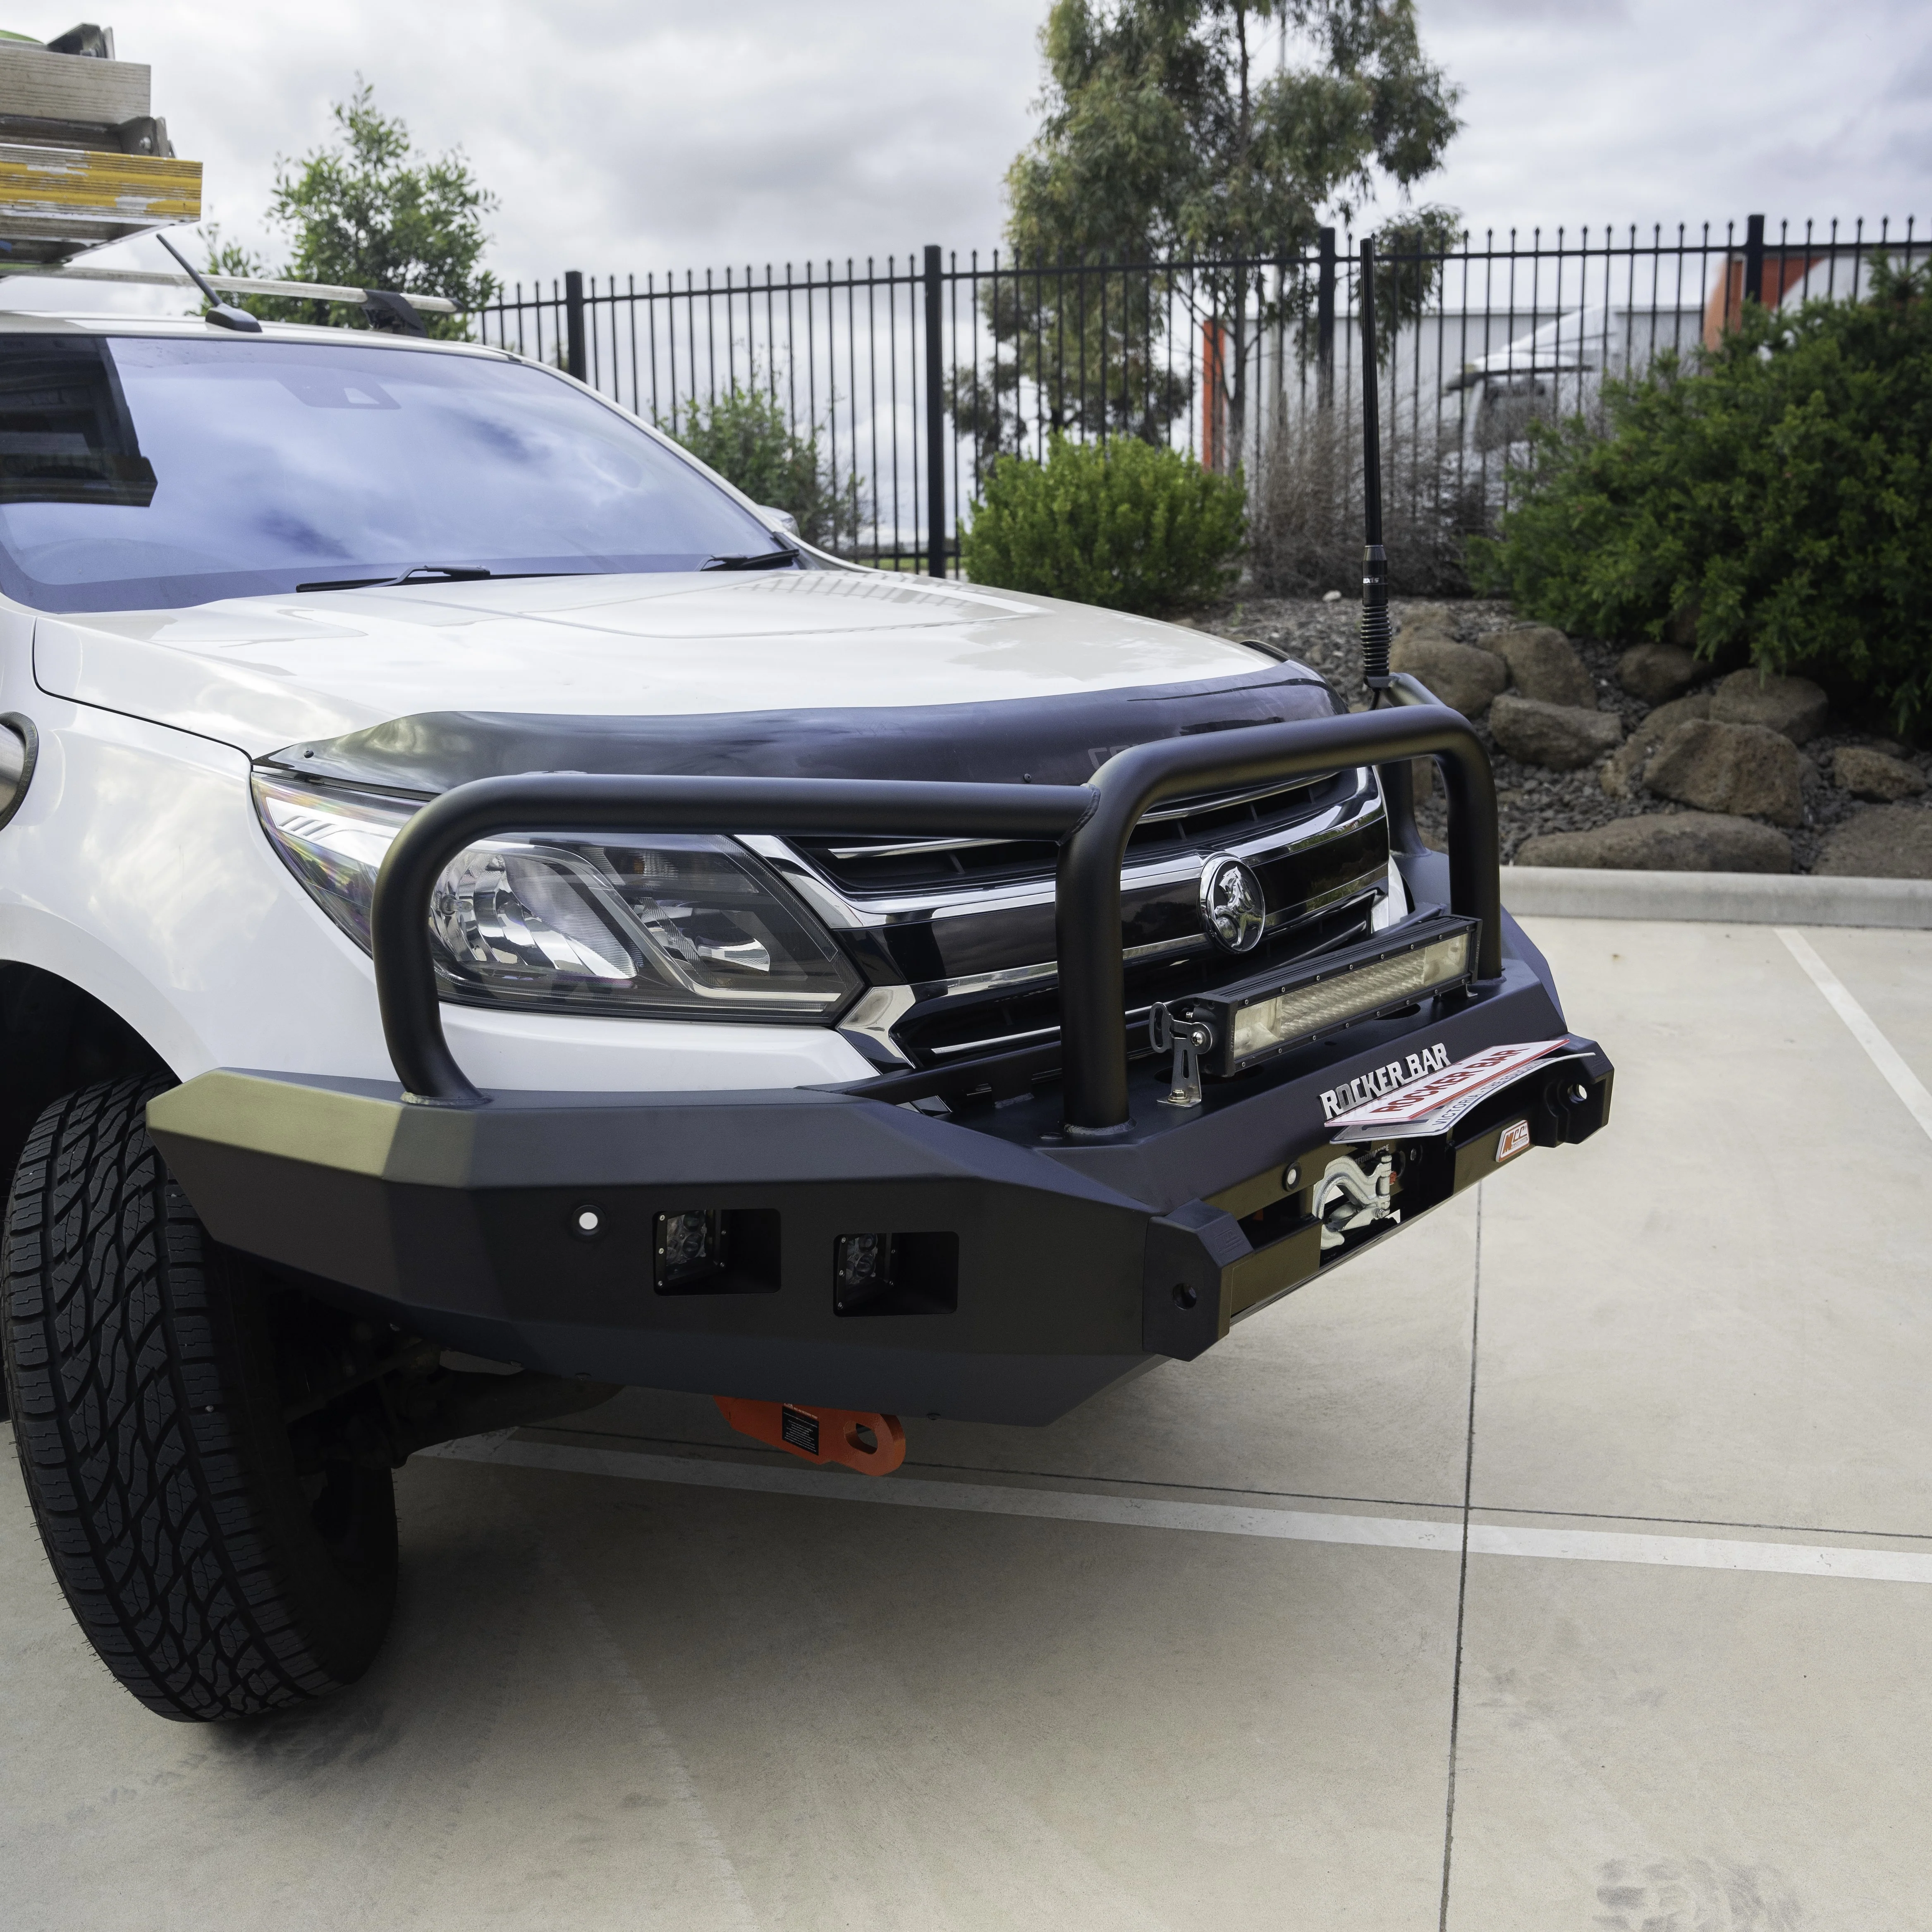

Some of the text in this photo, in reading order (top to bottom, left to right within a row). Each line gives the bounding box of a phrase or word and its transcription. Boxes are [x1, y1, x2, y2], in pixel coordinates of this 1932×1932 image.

[1319, 1061, 1407, 1120] ROCKER
[1405, 1043, 1451, 1079] BAR
[1368, 1047, 1530, 1113] ROCKER BAR
[1432, 1093, 1482, 1126] VICTORIA
[1480, 1080, 1506, 1090] THE
[1502, 1125, 1527, 1155] MCC
